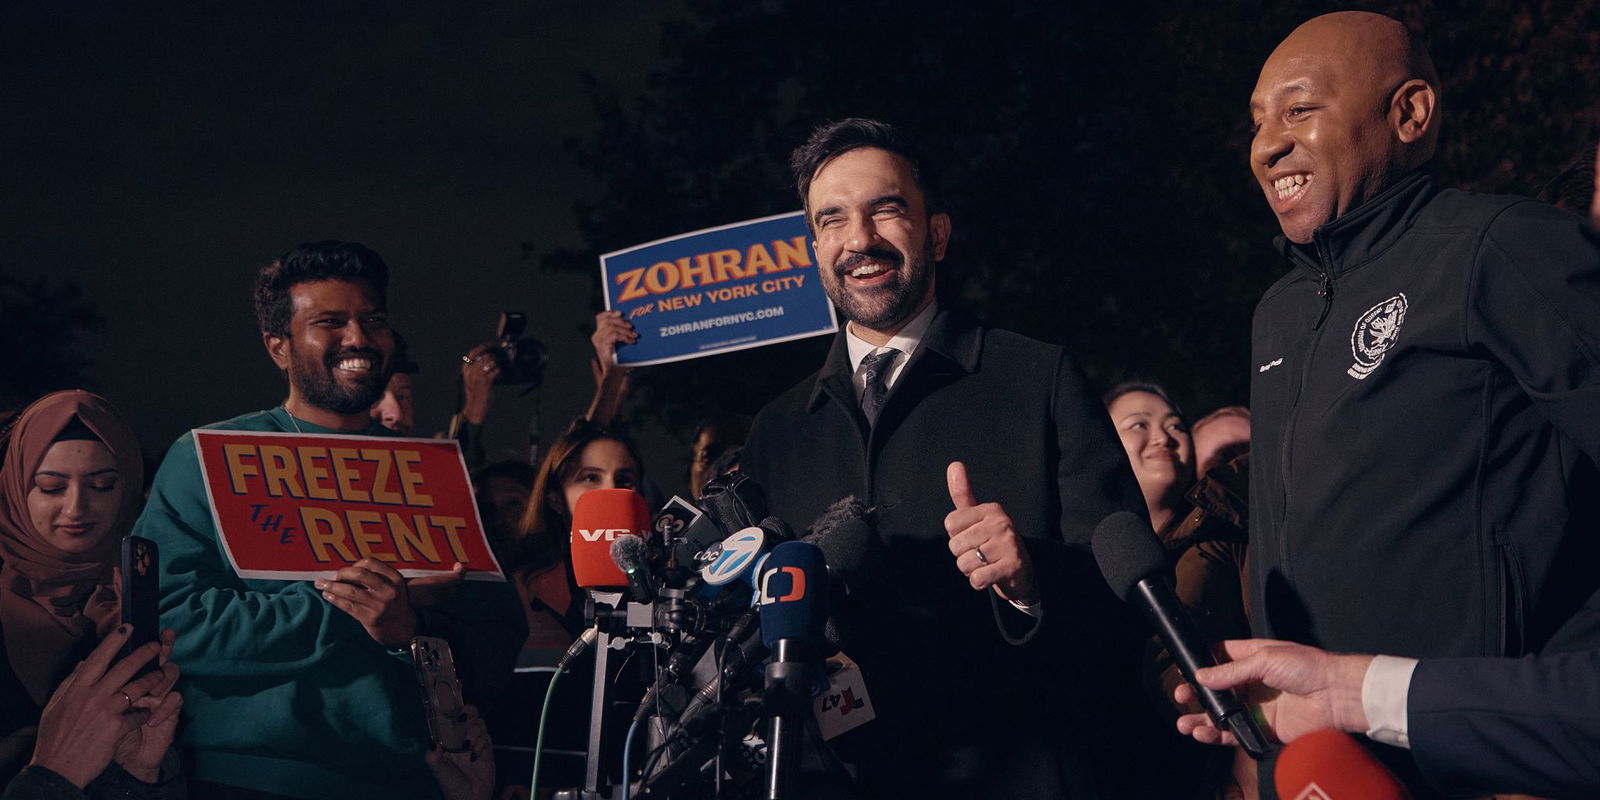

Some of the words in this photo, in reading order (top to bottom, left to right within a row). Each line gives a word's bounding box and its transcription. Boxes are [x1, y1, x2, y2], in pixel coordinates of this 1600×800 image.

[615, 235, 813, 303] ZOHRAN
[629, 304, 655, 320] FOR
[658, 293, 703, 313] NEW
[706, 284, 758, 304] YORK
[762, 275, 806, 294] CITY
[660, 307, 784, 338] ZOHRANFORNYC.COM
[222, 443, 434, 507] FREEZE
[248, 504, 298, 545] THE
[298, 507, 471, 564] RENT
[578, 529, 631, 542] VG
[693, 547, 719, 562] abc
[821, 694, 841, 712] 47
